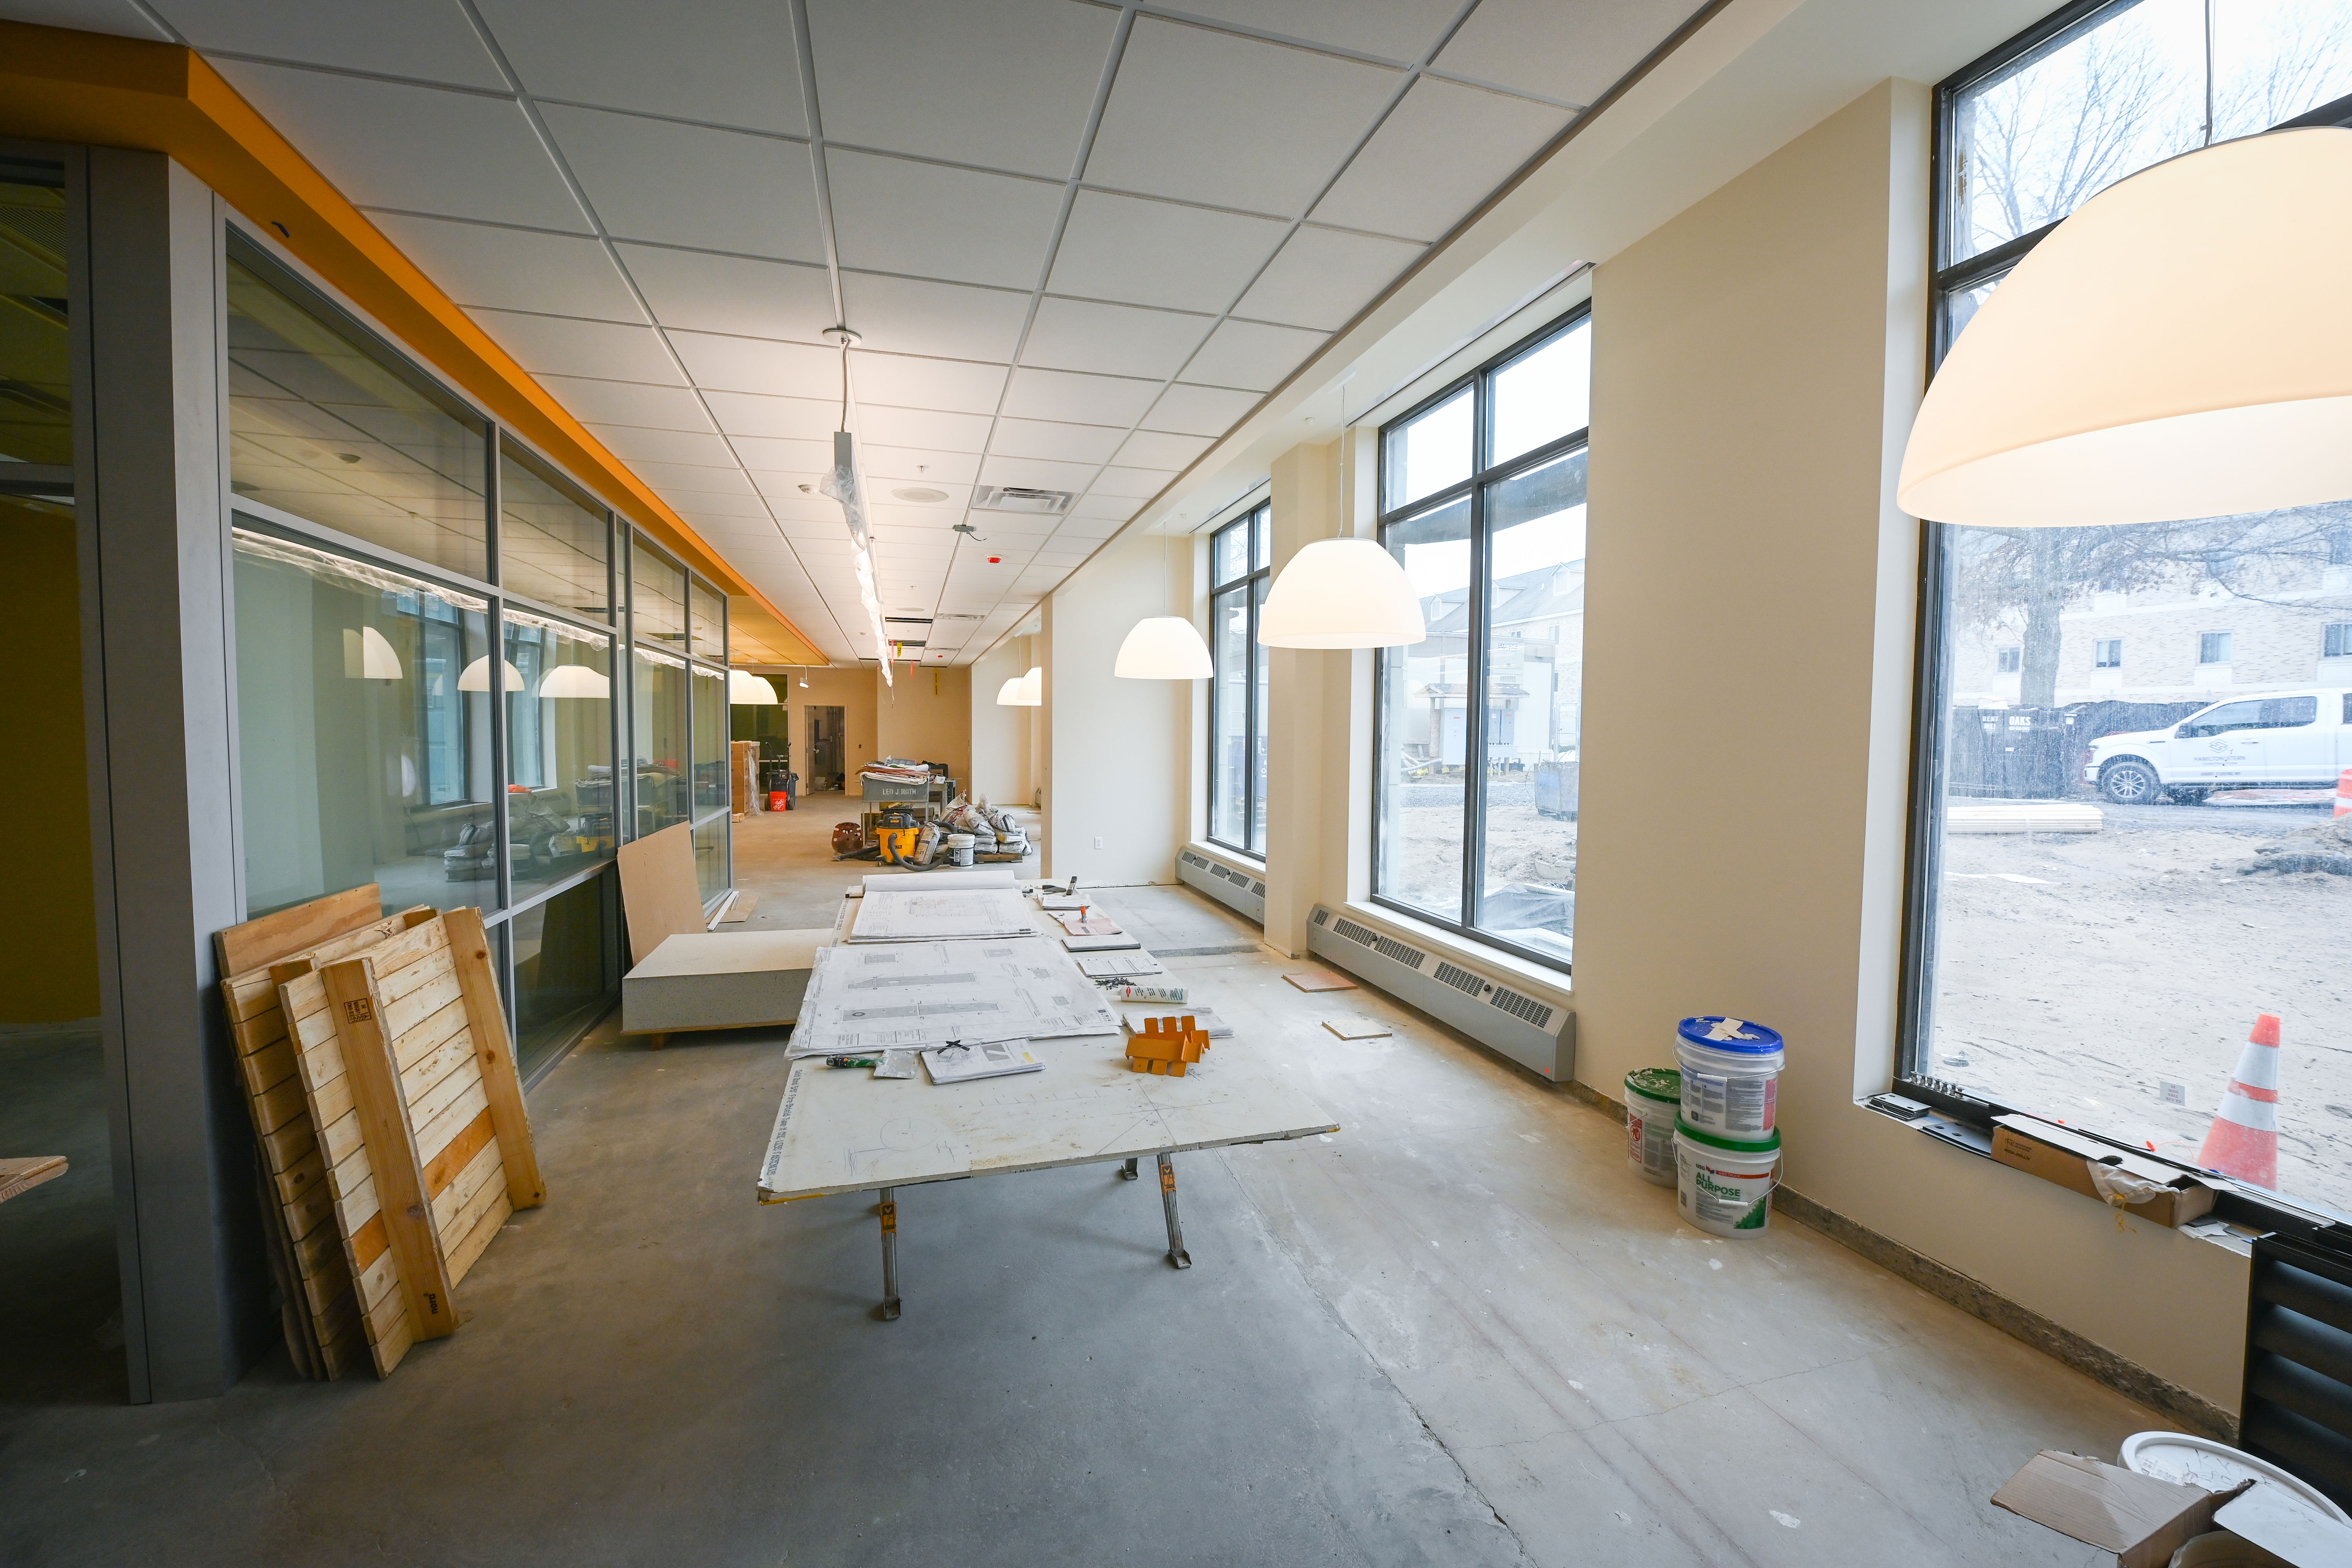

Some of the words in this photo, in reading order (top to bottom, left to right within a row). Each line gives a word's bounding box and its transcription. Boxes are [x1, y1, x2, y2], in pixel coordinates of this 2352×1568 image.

[2009, 716, 2031, 725] OAKS
[1696, 1172, 1713, 1184] ALL
[1696, 1179, 1740, 1196] PURPOSE
[429, 1294, 438, 1314] nora
